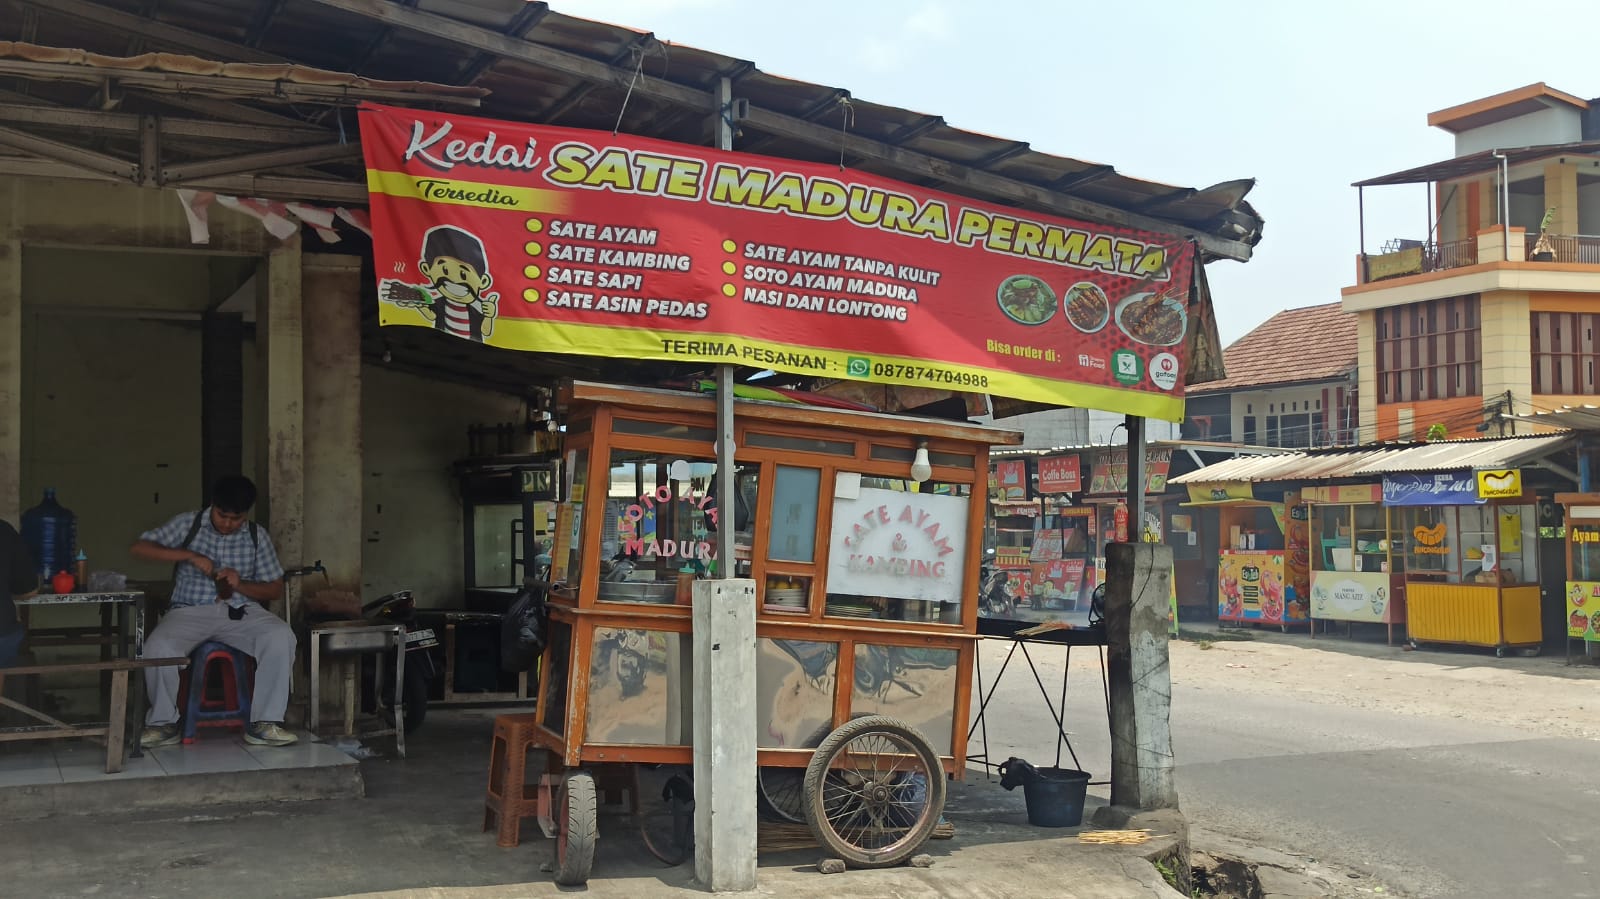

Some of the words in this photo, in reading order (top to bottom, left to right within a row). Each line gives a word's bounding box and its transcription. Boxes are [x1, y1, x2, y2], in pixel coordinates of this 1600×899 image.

[404, 120, 542, 171] Kedai
[542, 141, 707, 202] SATE
[707, 161, 951, 243] MADURA
[954, 207, 1171, 281] PERMATA
[416, 180, 519, 206] Tersedia
[549, 220, 596, 240] SATE
[598, 226, 657, 245] AYAM
[548, 244, 595, 263] SATE
[598, 250, 691, 271] KAMBING
[744, 243, 786, 262] SATE
[787, 250, 840, 270] AYAM
[844, 255, 895, 277] TANPA
[898, 266, 940, 286] KULIT
[547, 267, 594, 286] SATE
[597, 272, 642, 290] SAPI
[744, 265, 788, 285] SOTO
[790, 273, 843, 291] AYAM
[846, 279, 918, 302] MADURA
[546, 291, 593, 309] SATE
[595, 296, 642, 313] ASIN
[645, 300, 708, 318] PEDAS
[744, 287, 783, 306] NASI
[785, 293, 825, 311] DAN
[827, 298, 907, 321] LONTONG
[661, 339, 738, 357] TERIMA
[742, 346, 826, 370] PESANAN
[874, 363, 988, 388] 087874704988
[986, 339, 1011, 354] Bisa
[1013, 344, 1043, 360] order
[1044, 349, 1056, 362] di
[898, 504, 954, 558] AYAM
[1572, 527, 1599, 545] Ayam
[625, 538, 718, 560] MADUR
